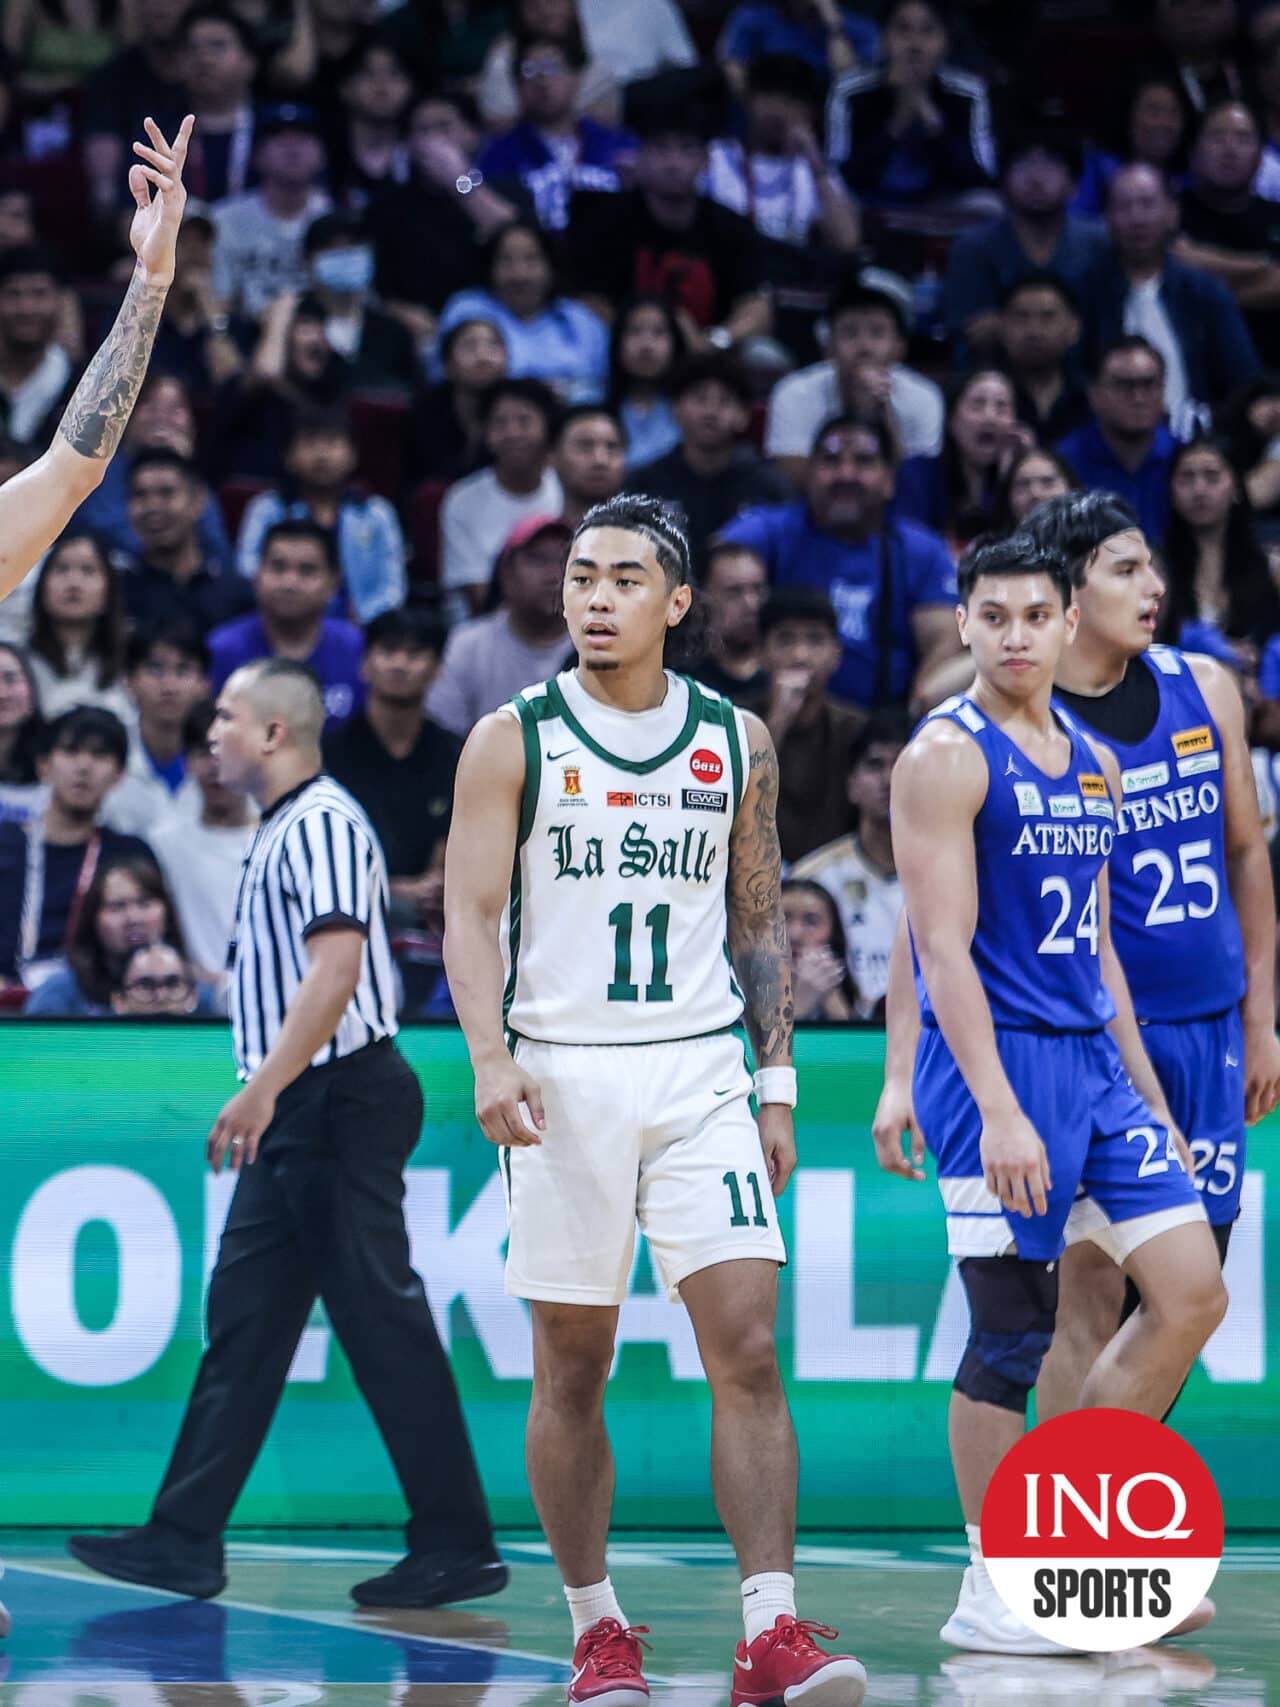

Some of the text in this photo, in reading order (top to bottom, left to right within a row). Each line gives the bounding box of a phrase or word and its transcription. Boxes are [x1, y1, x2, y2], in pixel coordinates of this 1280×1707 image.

[633, 793, 671, 807] ICTSI
[547, 821, 717, 884] La Salle
[1011, 822, 1113, 857] ATENEO
[1132, 838, 1219, 928] 25
[1036, 875, 1099, 957] 24
[607, 902, 674, 1003] 11
[1188, 1138, 1237, 1196] 25
[722, 1171, 769, 1228] 11
